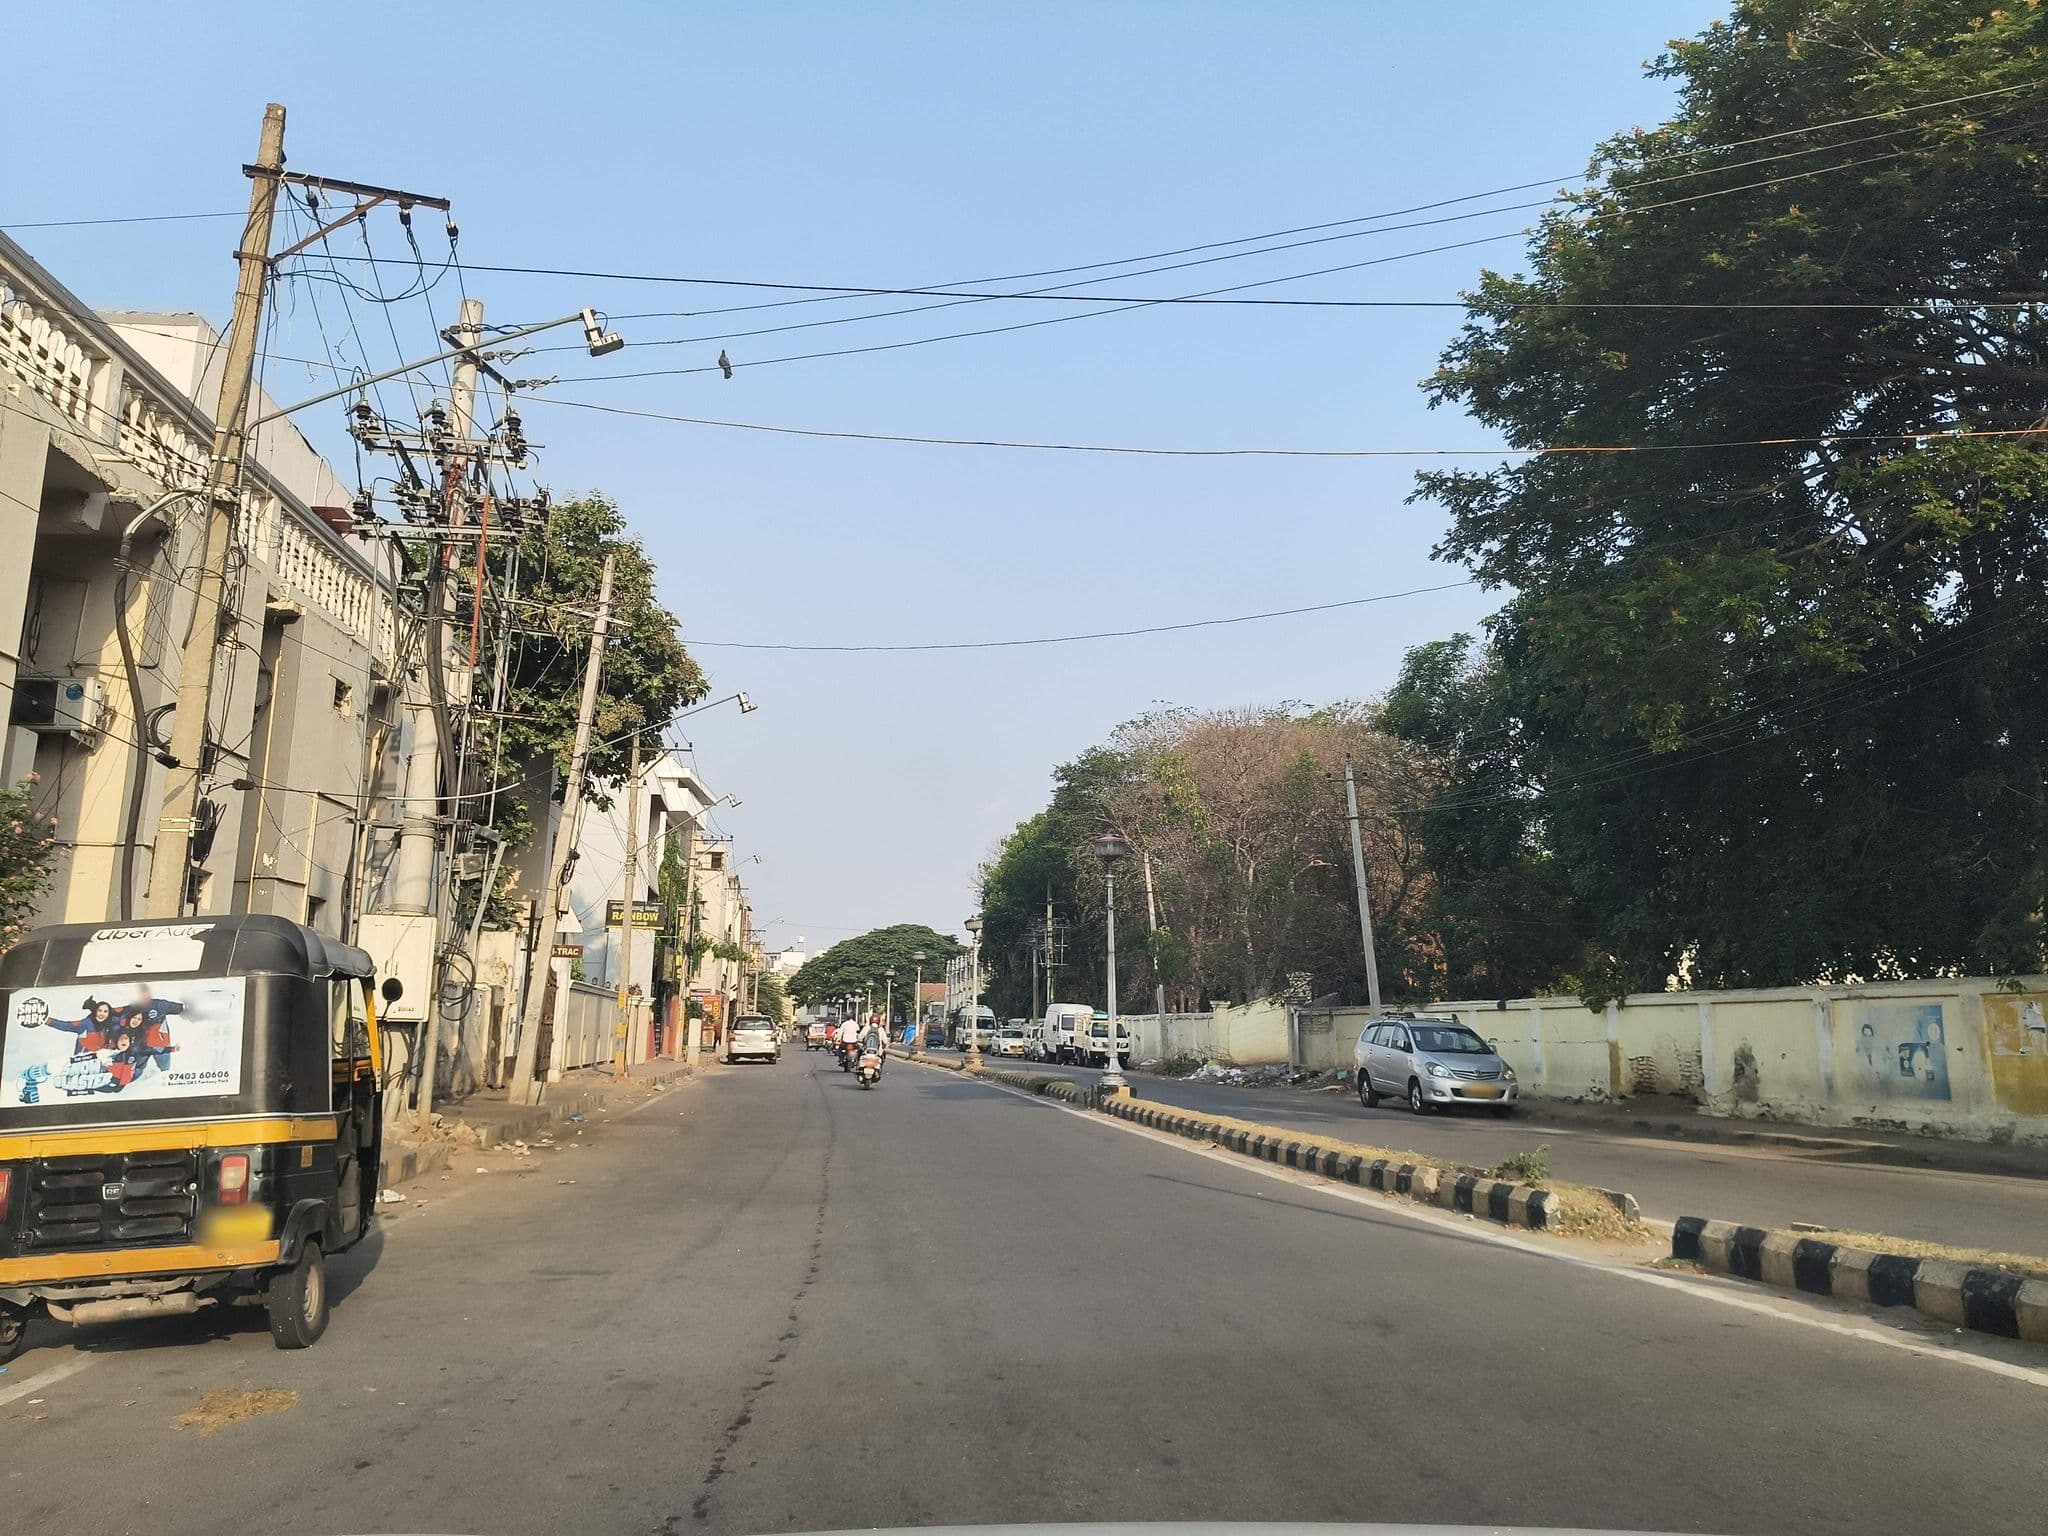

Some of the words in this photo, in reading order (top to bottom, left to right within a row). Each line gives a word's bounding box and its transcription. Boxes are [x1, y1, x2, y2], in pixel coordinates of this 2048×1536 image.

[612, 911, 660, 921] RANBOW
[18, 1003, 48, 1014] SNOW
[18, 1012, 47, 1025] PARK
[168, 1072, 196, 1081] 97403
[199, 1070, 229, 1079] 60606
